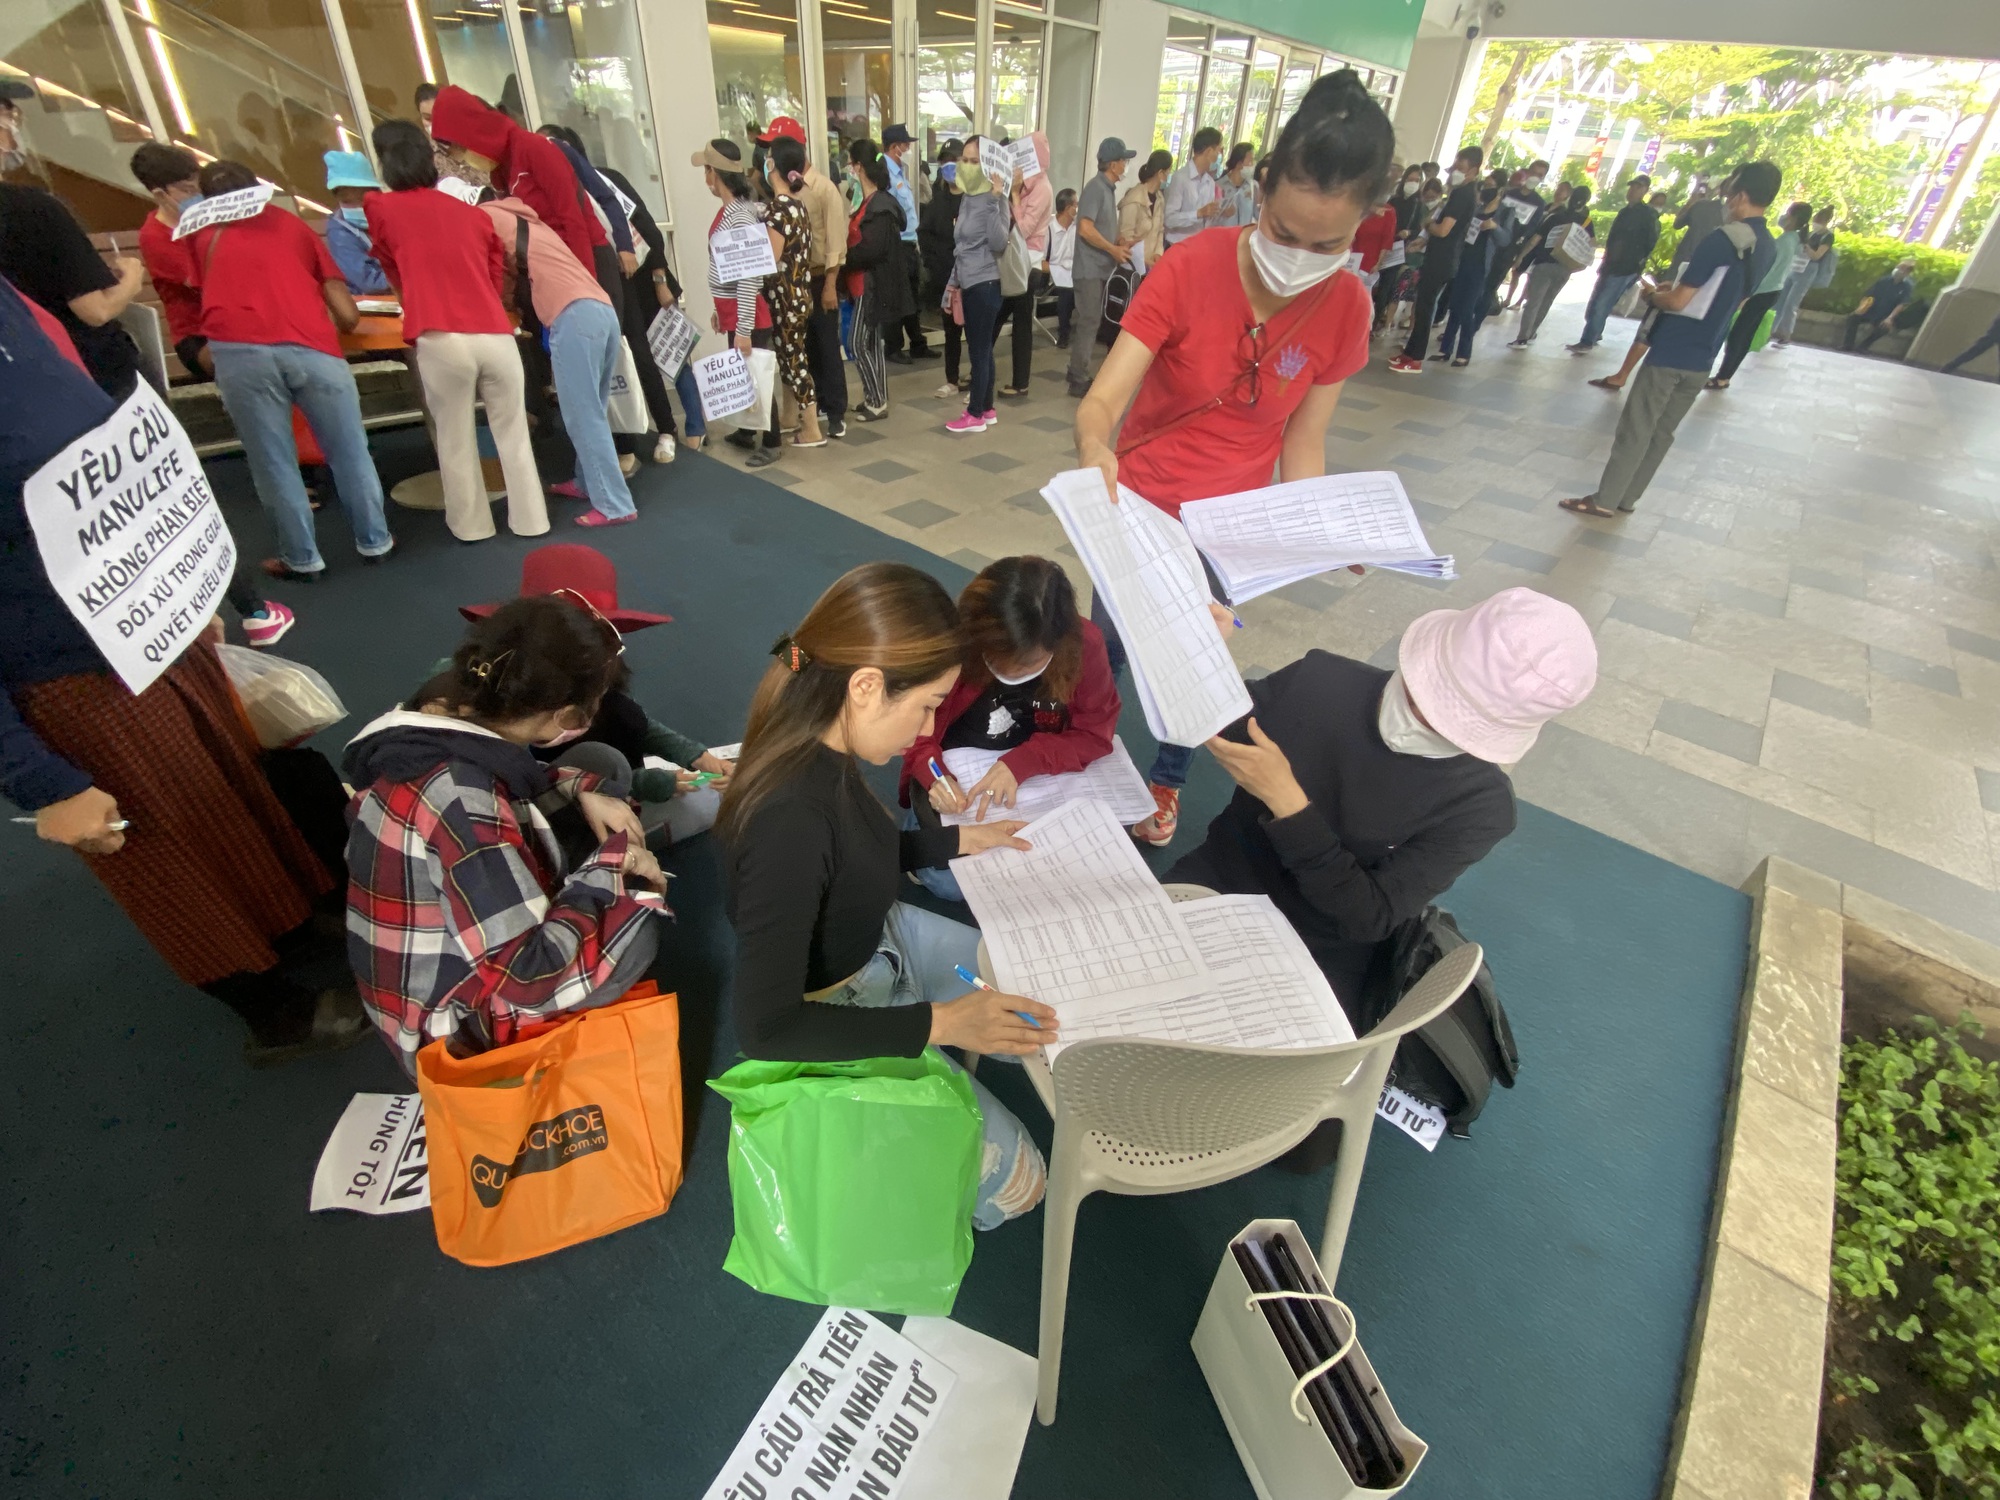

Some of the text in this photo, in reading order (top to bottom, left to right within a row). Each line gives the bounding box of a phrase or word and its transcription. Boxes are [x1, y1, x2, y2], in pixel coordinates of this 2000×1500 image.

[703, 384, 726, 398] KHÔNG
[704, 357, 724, 373] YÊU
[56, 402, 170, 512] YÊU CẦU
[77, 448, 184, 557] MANULIFE
[77, 543, 148, 613] KHÔNG
[147, 508, 188, 556] PHÂN
[116, 602, 155, 639] ĐỐI
[149, 573, 174, 607] XỬ
[169, 540, 207, 590] TRONG
[144, 610, 192, 663] QUYẾT
[191, 567, 220, 615] KHIẾU
[346, 1159, 381, 1200] TÔI
[754, 1411, 803, 1477] CẦU
[788, 1361, 836, 1419] TRẢ
[819, 1311, 868, 1369] TIỀN
[804, 1423, 857, 1492] NẠN
[839, 1350, 899, 1431] NHÂN
[871, 1412, 920, 1478] ĐẦU
